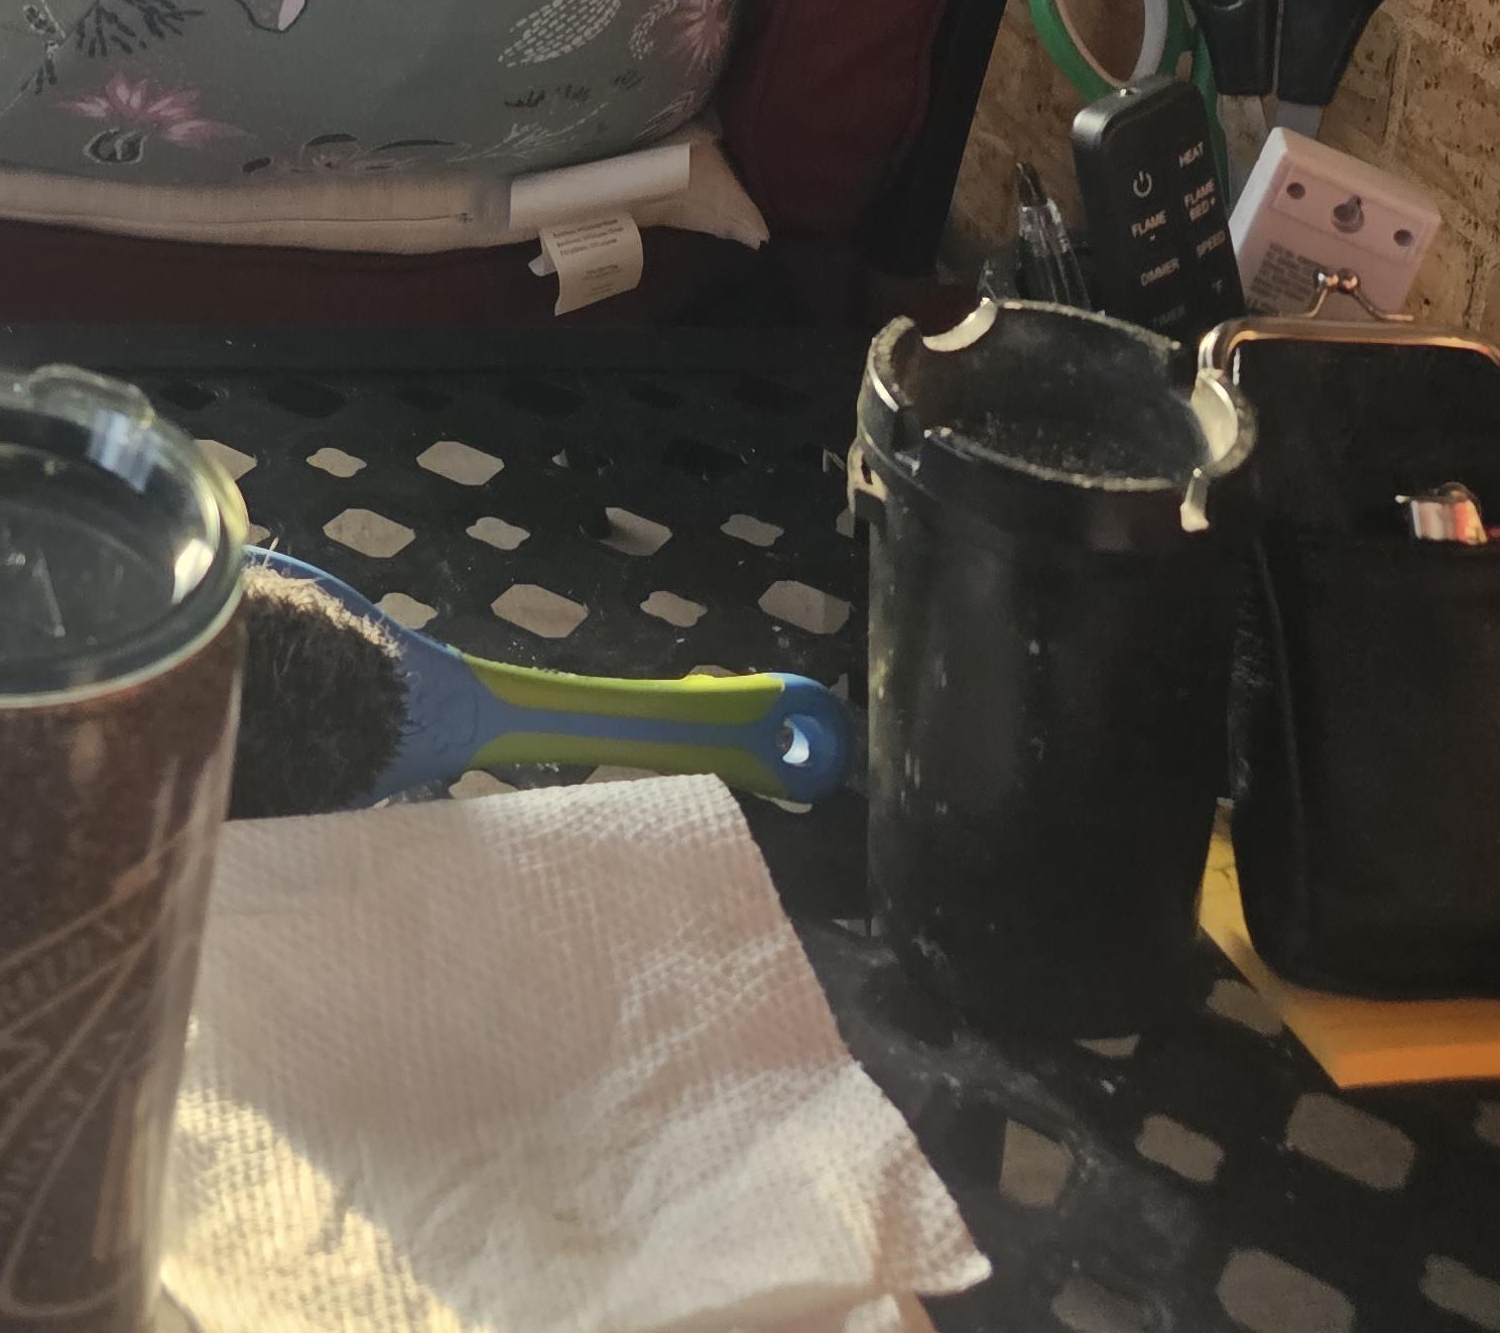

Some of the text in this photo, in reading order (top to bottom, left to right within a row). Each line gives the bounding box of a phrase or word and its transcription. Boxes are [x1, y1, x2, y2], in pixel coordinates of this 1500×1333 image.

[1178, 141, 1205, 169] HEAT
[1183, 177, 1216, 209] FLAME
[1131, 209, 1167, 238] FLAME
